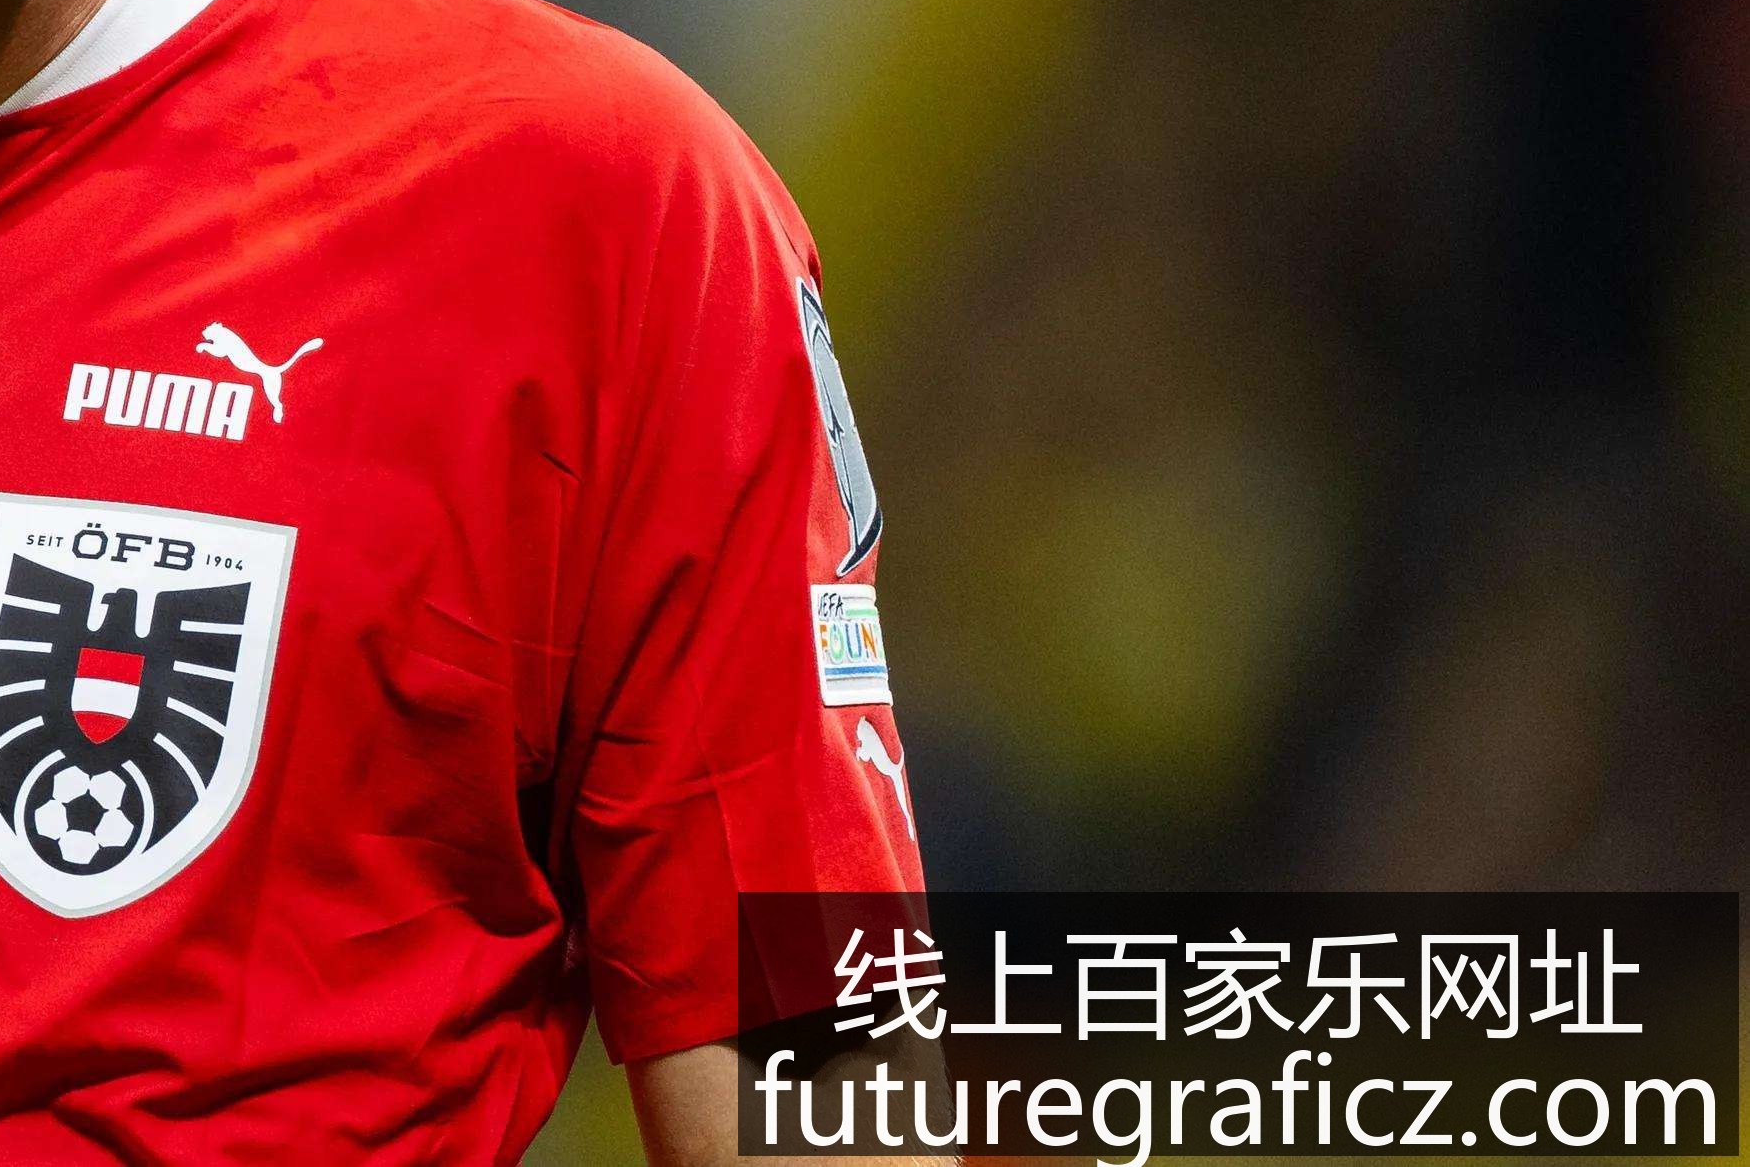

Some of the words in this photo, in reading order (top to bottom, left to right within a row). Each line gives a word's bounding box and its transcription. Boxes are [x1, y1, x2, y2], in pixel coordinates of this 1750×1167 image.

[63, 362, 254, 442] PUMA
[26, 534, 64, 548] SEIT
[72, 522, 196, 572] ÖFB
[206, 554, 244, 571] 1904
